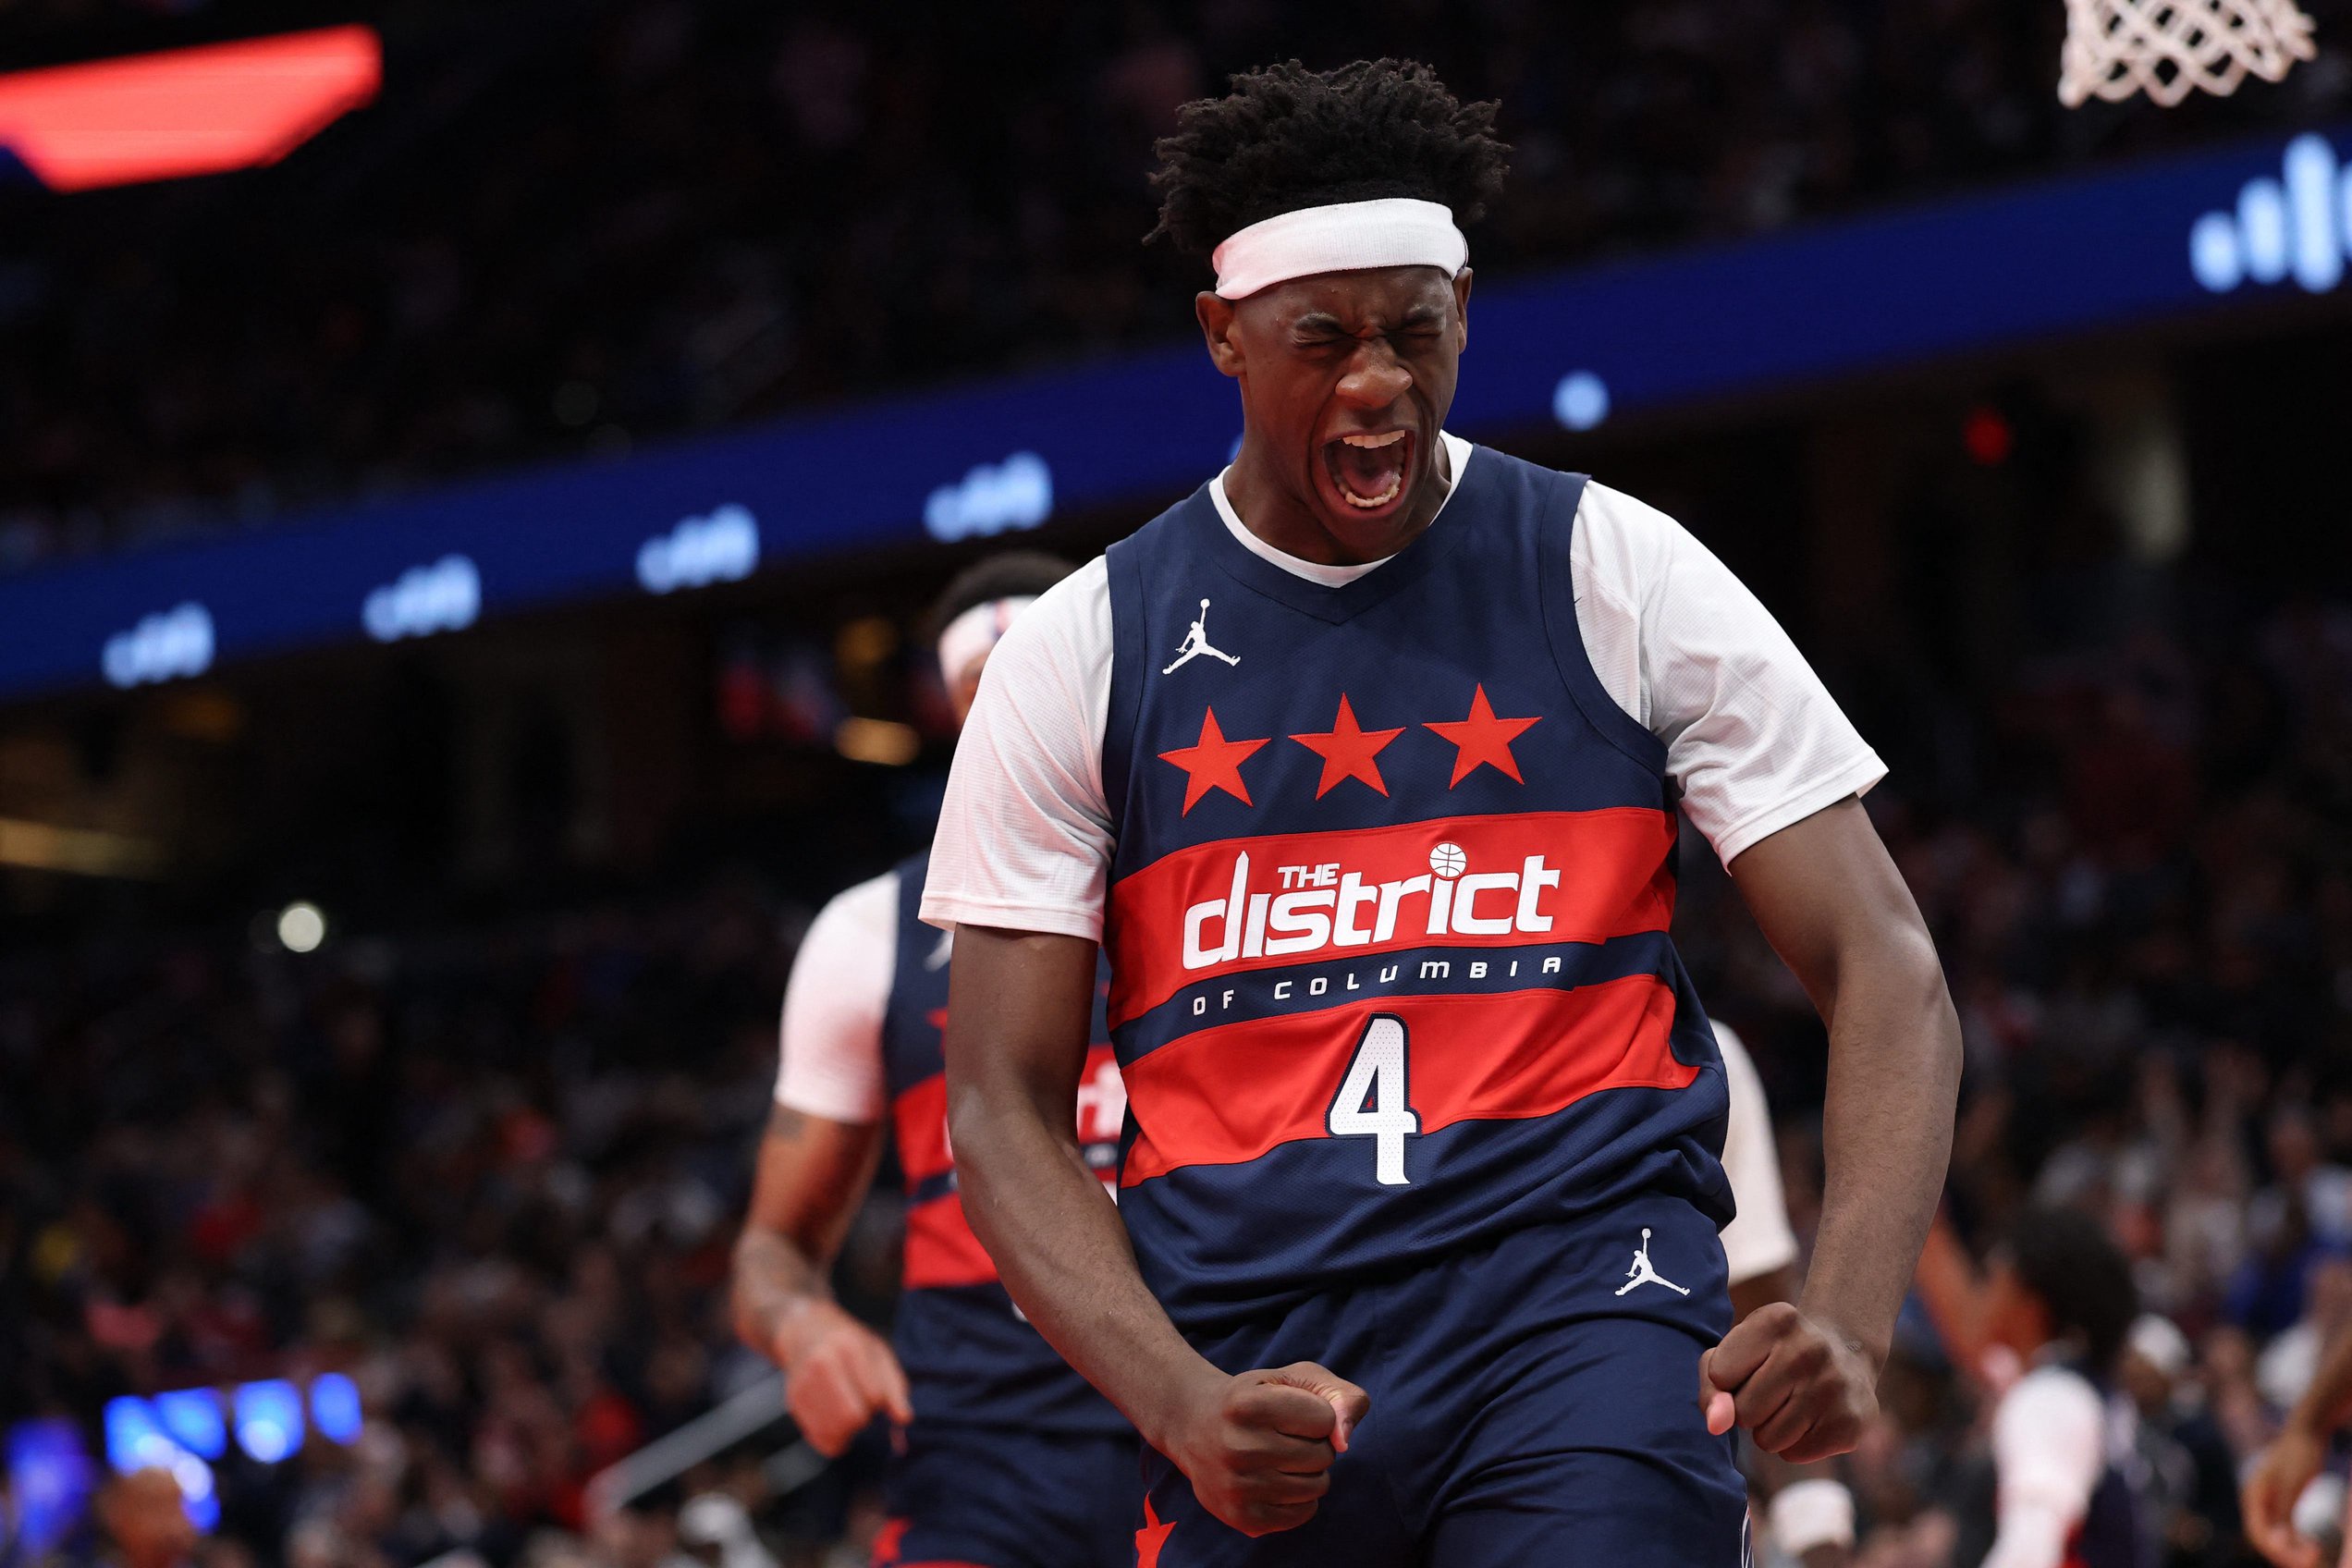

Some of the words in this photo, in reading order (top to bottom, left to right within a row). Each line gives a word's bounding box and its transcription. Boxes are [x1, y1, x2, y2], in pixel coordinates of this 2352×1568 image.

[1182, 841, 1562, 971] district
[1277, 862, 1341, 890] THE
[1192, 988, 1236, 1016] OF
[1273, 955, 1562, 1000] COLUMBIA
[1329, 1016, 1418, 1186] 4
